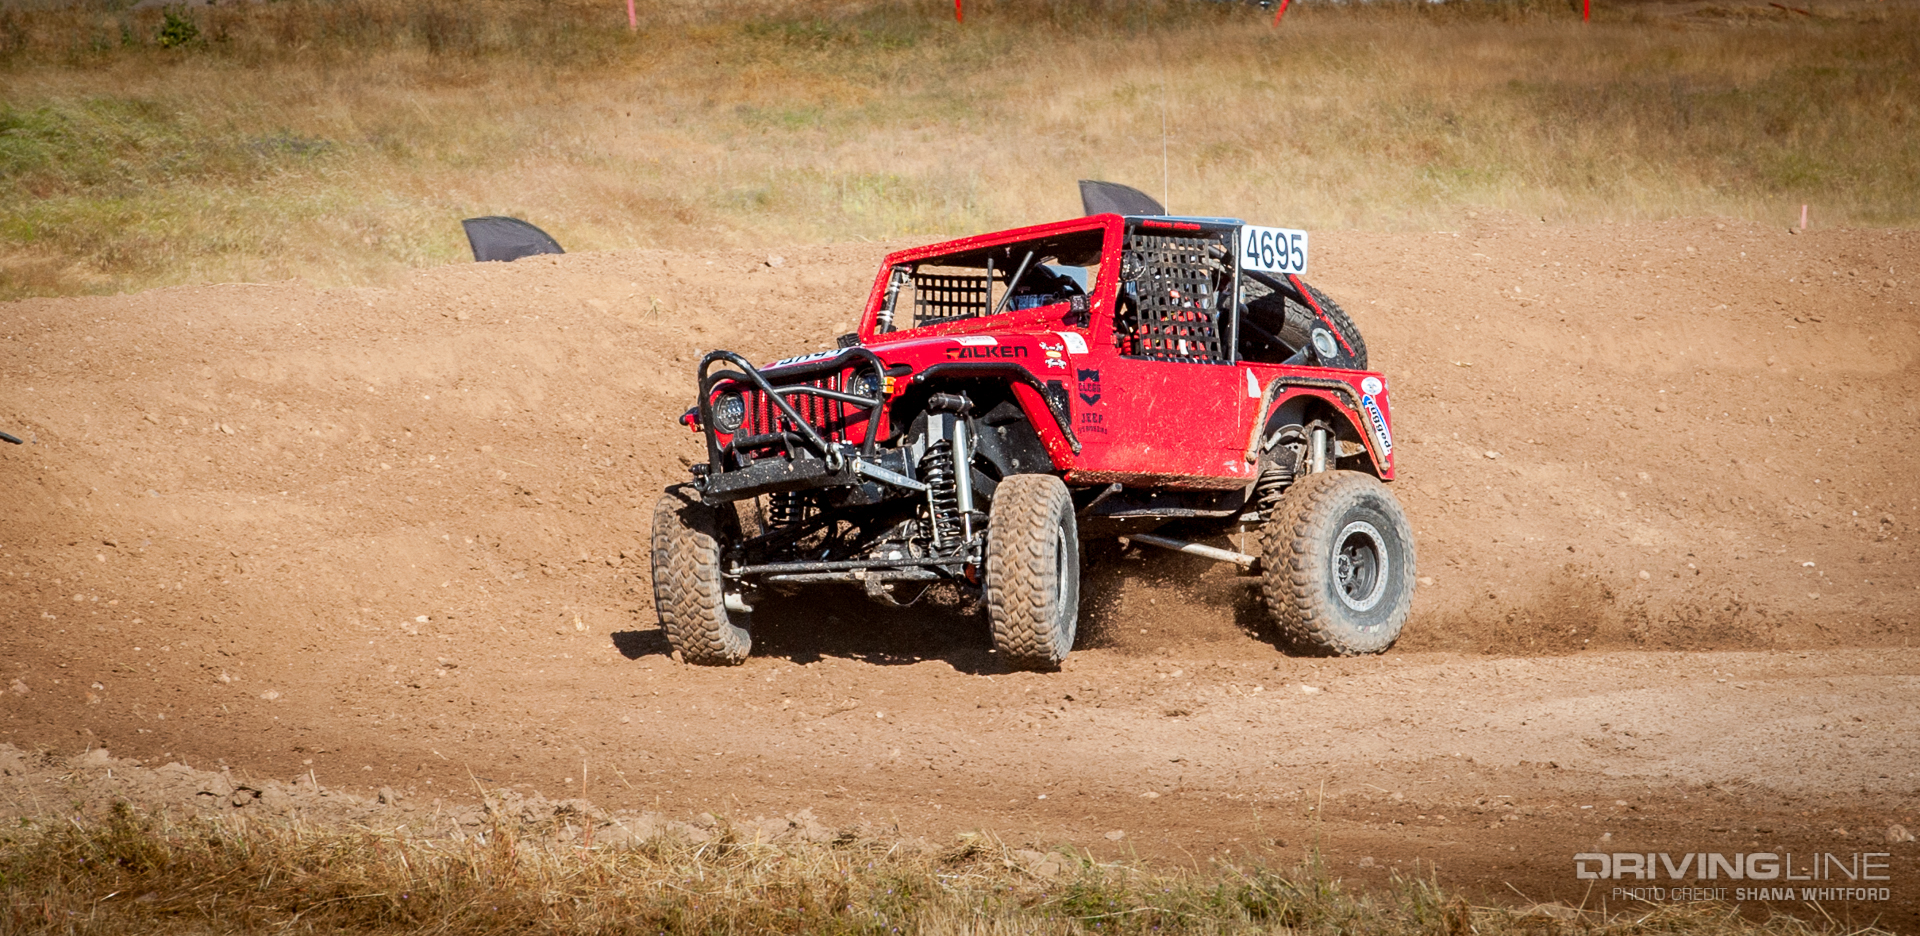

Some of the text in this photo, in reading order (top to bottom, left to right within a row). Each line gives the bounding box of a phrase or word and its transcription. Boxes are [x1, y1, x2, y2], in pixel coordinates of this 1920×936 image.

[1247, 229, 1304, 271] 4695
[943, 346, 1028, 360] FALKEN
[1081, 412, 1104, 424] JEEP
[1367, 400, 1392, 448] rugged
